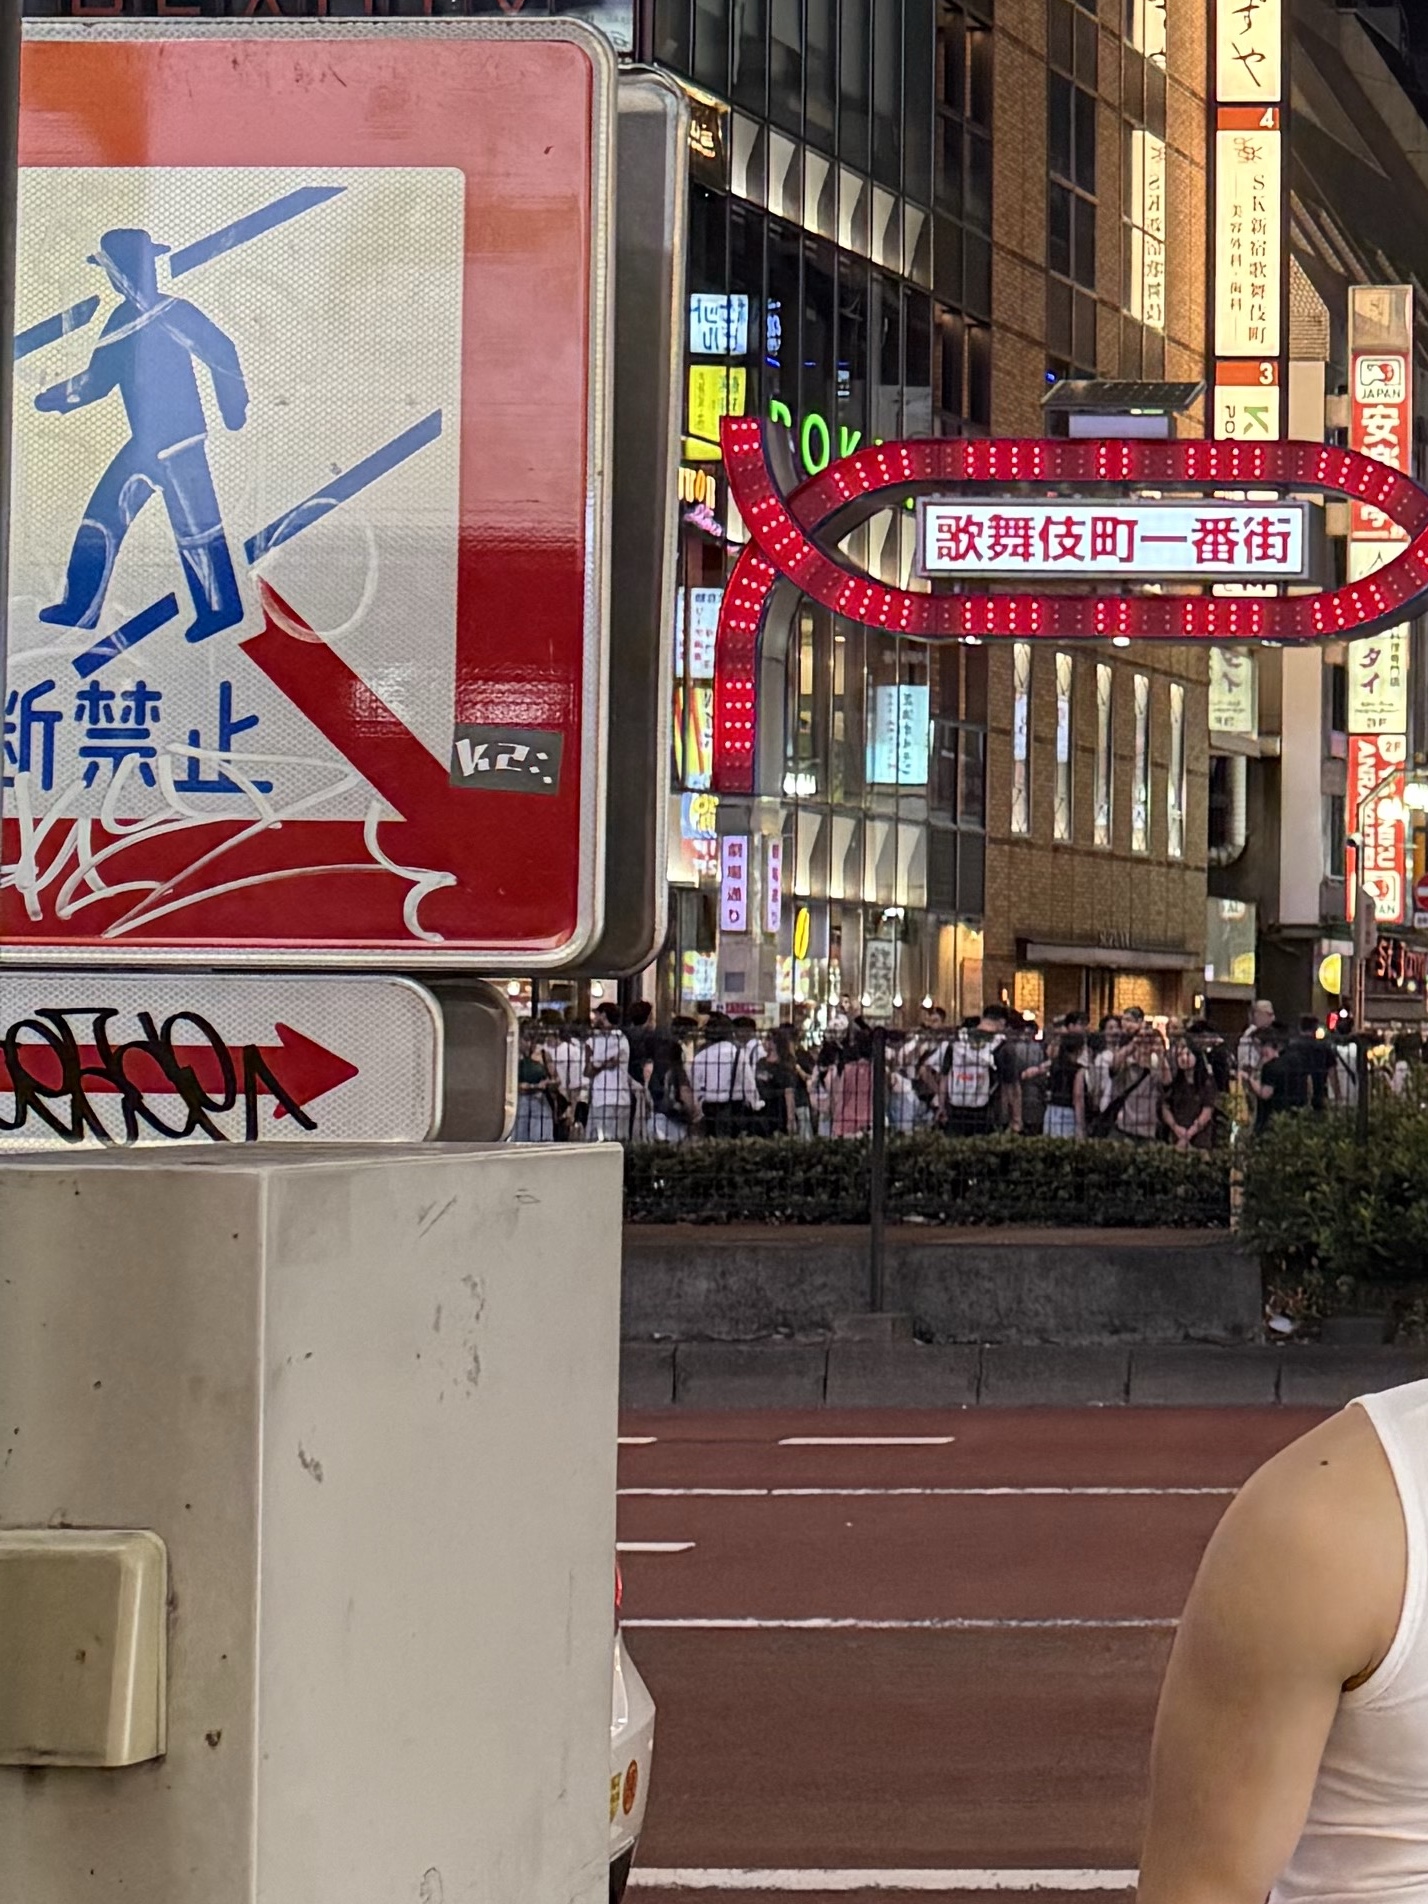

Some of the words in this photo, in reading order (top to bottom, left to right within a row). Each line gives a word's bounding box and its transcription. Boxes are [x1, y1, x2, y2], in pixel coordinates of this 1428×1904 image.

[1257, 108, 1276, 129] 4
[1259, 363, 1276, 384] 3
[1360, 386, 1402, 400] JAPAN
[935, 514, 1291, 565] 歌舞伎町一番街
